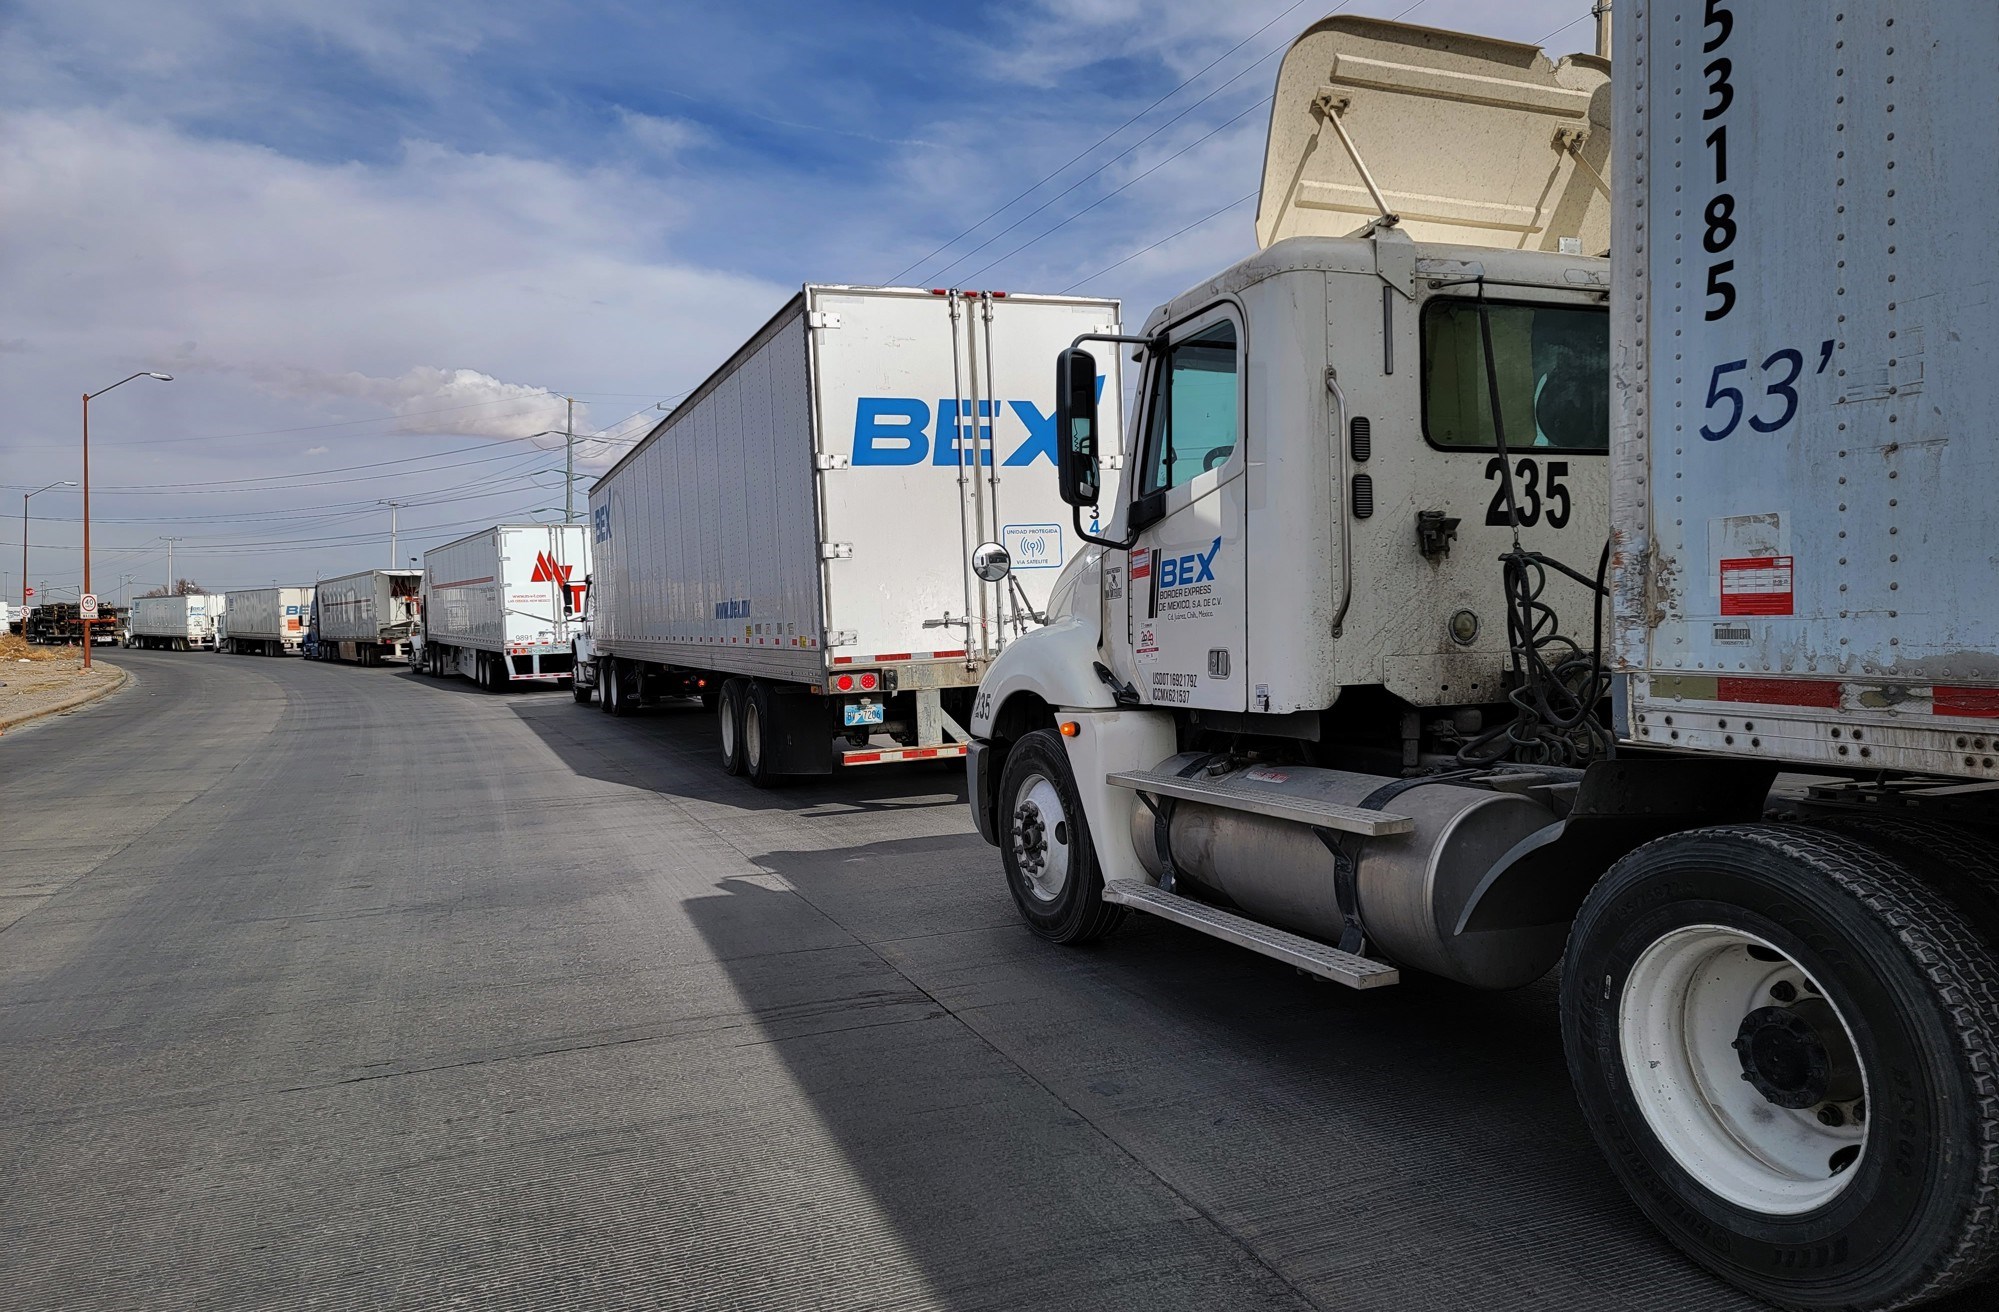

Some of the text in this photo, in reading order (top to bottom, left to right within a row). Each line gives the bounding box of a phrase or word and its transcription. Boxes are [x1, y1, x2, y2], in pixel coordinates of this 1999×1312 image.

[1698, 338, 1836, 443] 53'
[1484, 457, 1571, 530] 235
[595, 485, 612, 545] BEX
[1160, 536, 1221, 588] BEX
[286, 605, 310, 615] BE
[1158, 602, 1167, 612] DE
[1192, 599, 1203, 609] S.A.
[1203, 599, 1211, 607] DE
[1212, 597, 1222, 606] C.V.
[1159, 585, 1212, 600] BORDER EXPRESS
[974, 691, 992, 721] 235
